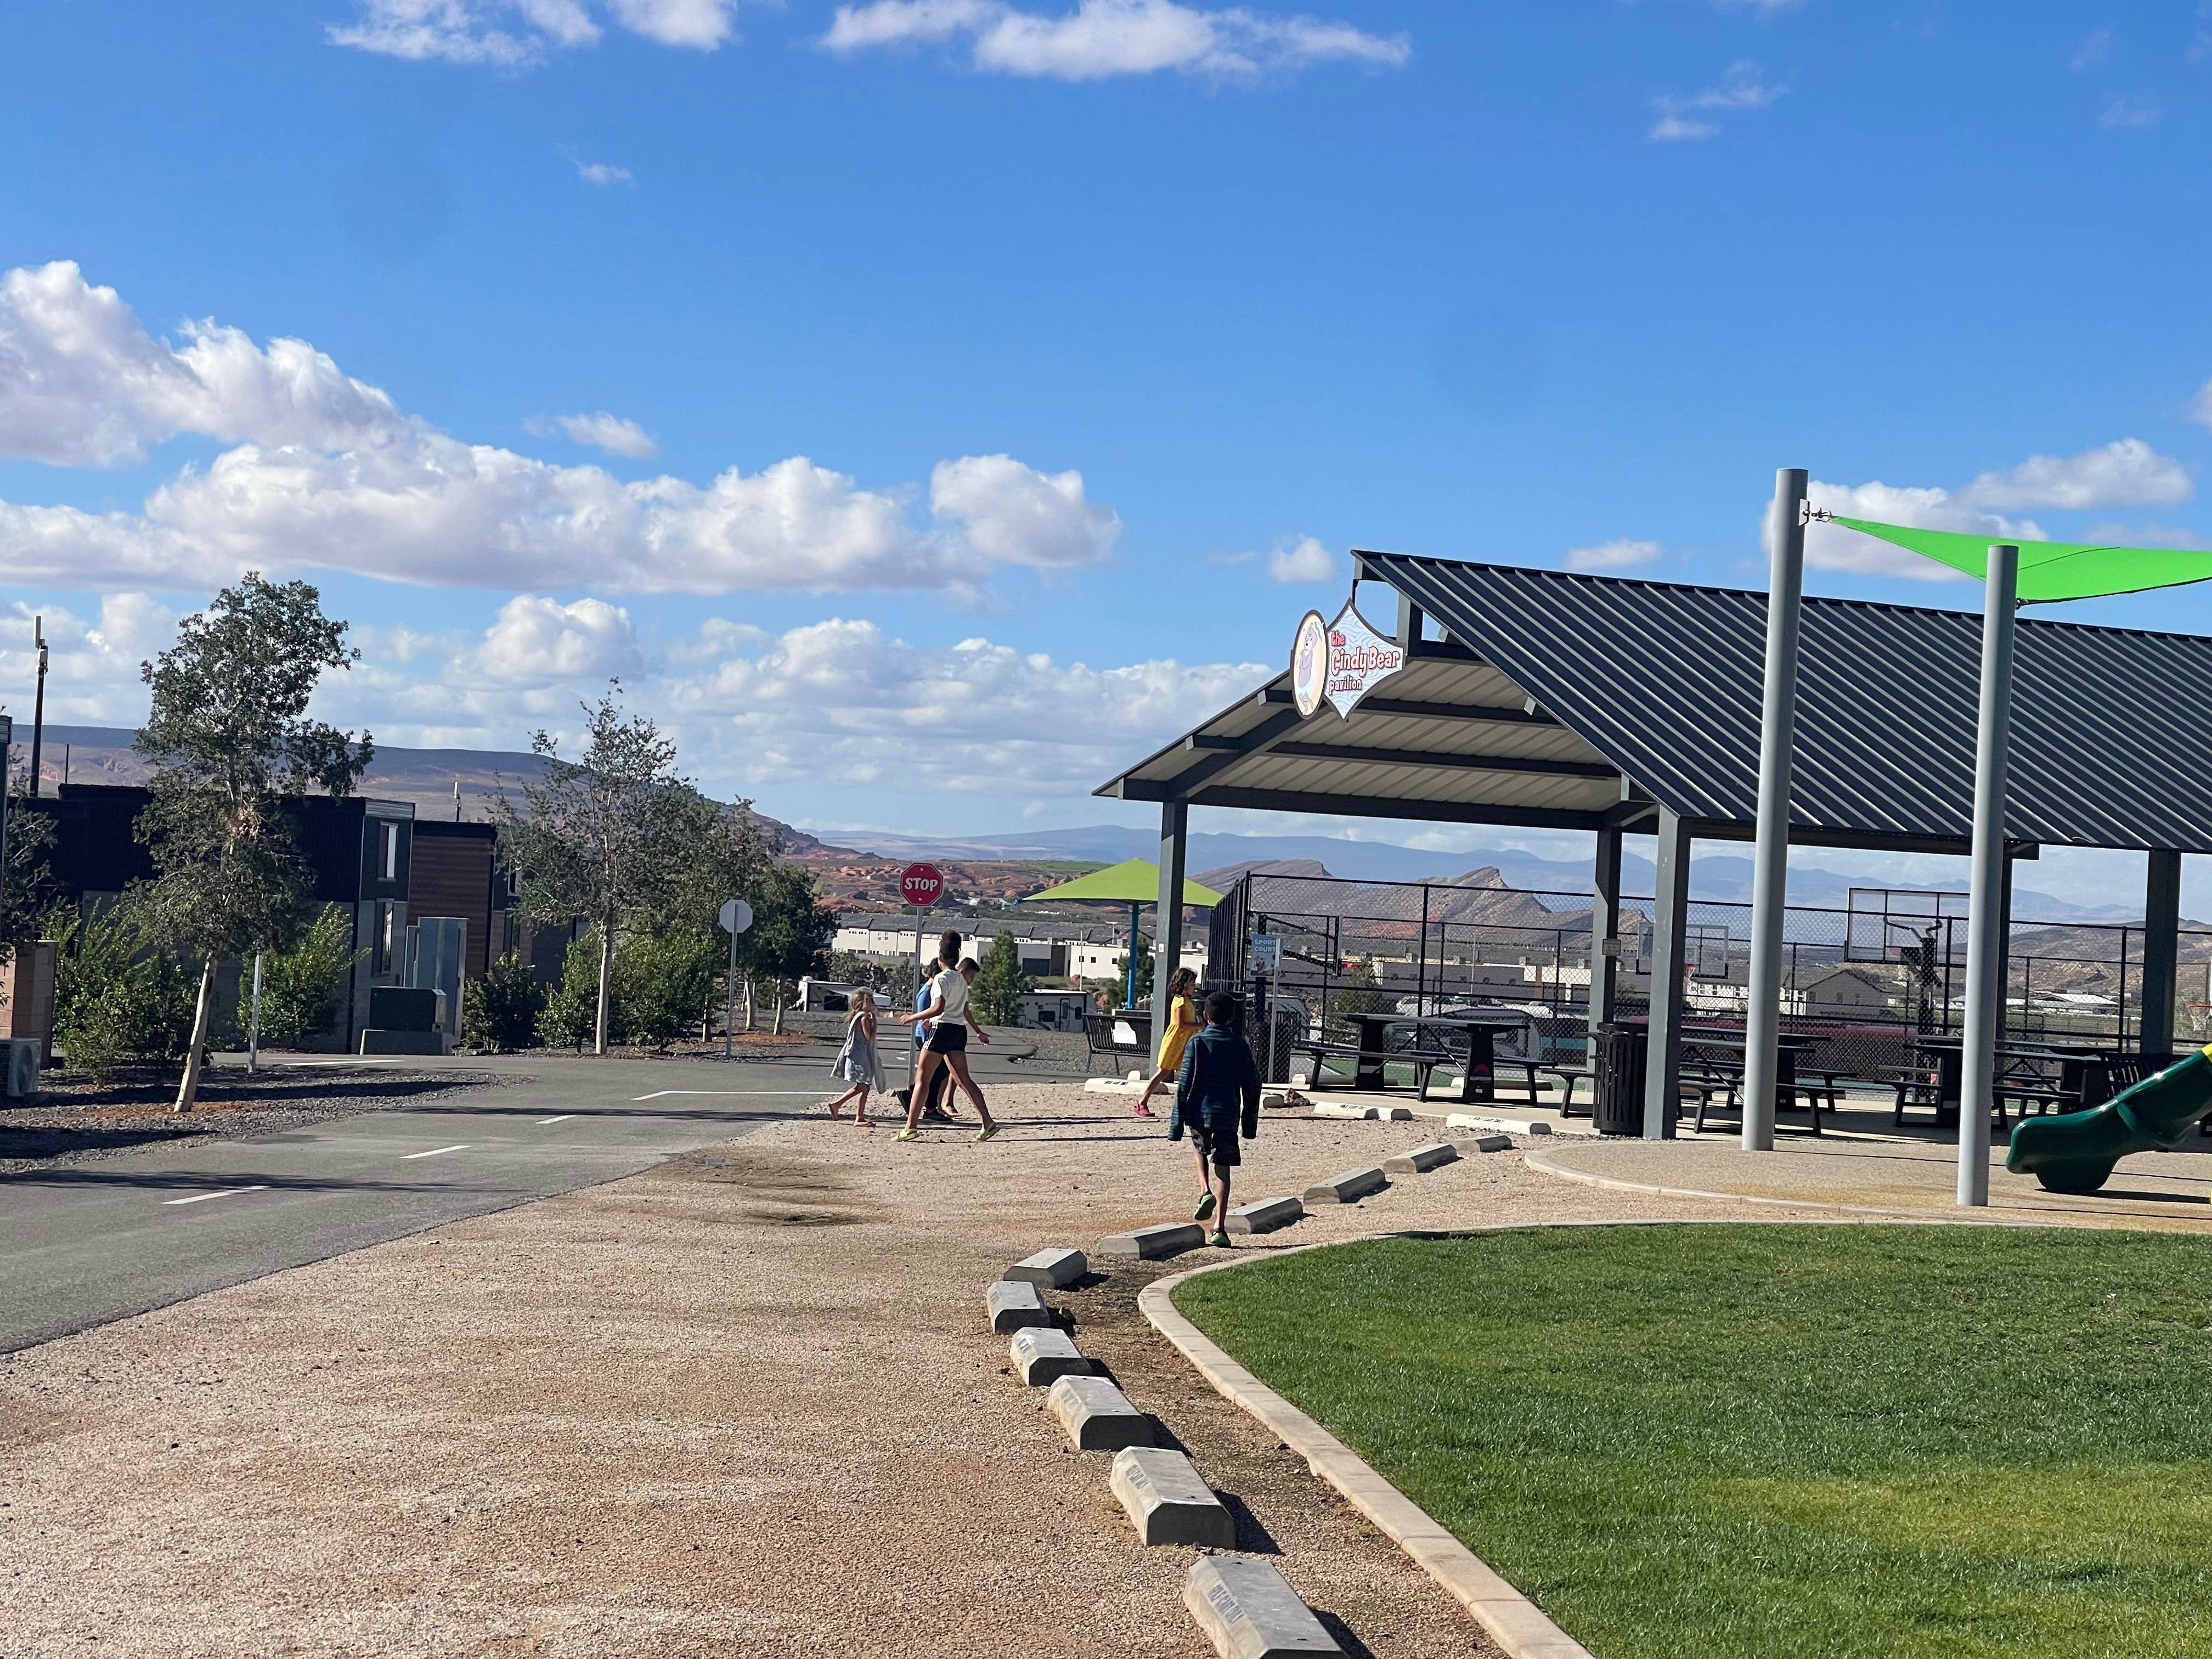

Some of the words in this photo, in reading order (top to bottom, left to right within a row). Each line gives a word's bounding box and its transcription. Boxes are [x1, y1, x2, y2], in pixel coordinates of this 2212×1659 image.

[1331, 630, 1346, 646] the
[1331, 646, 1368, 678] Cindy
[1368, 646, 1400, 669] Bear
[1329, 674, 1362, 696] pavilion
[904, 877, 939, 891] STOP
